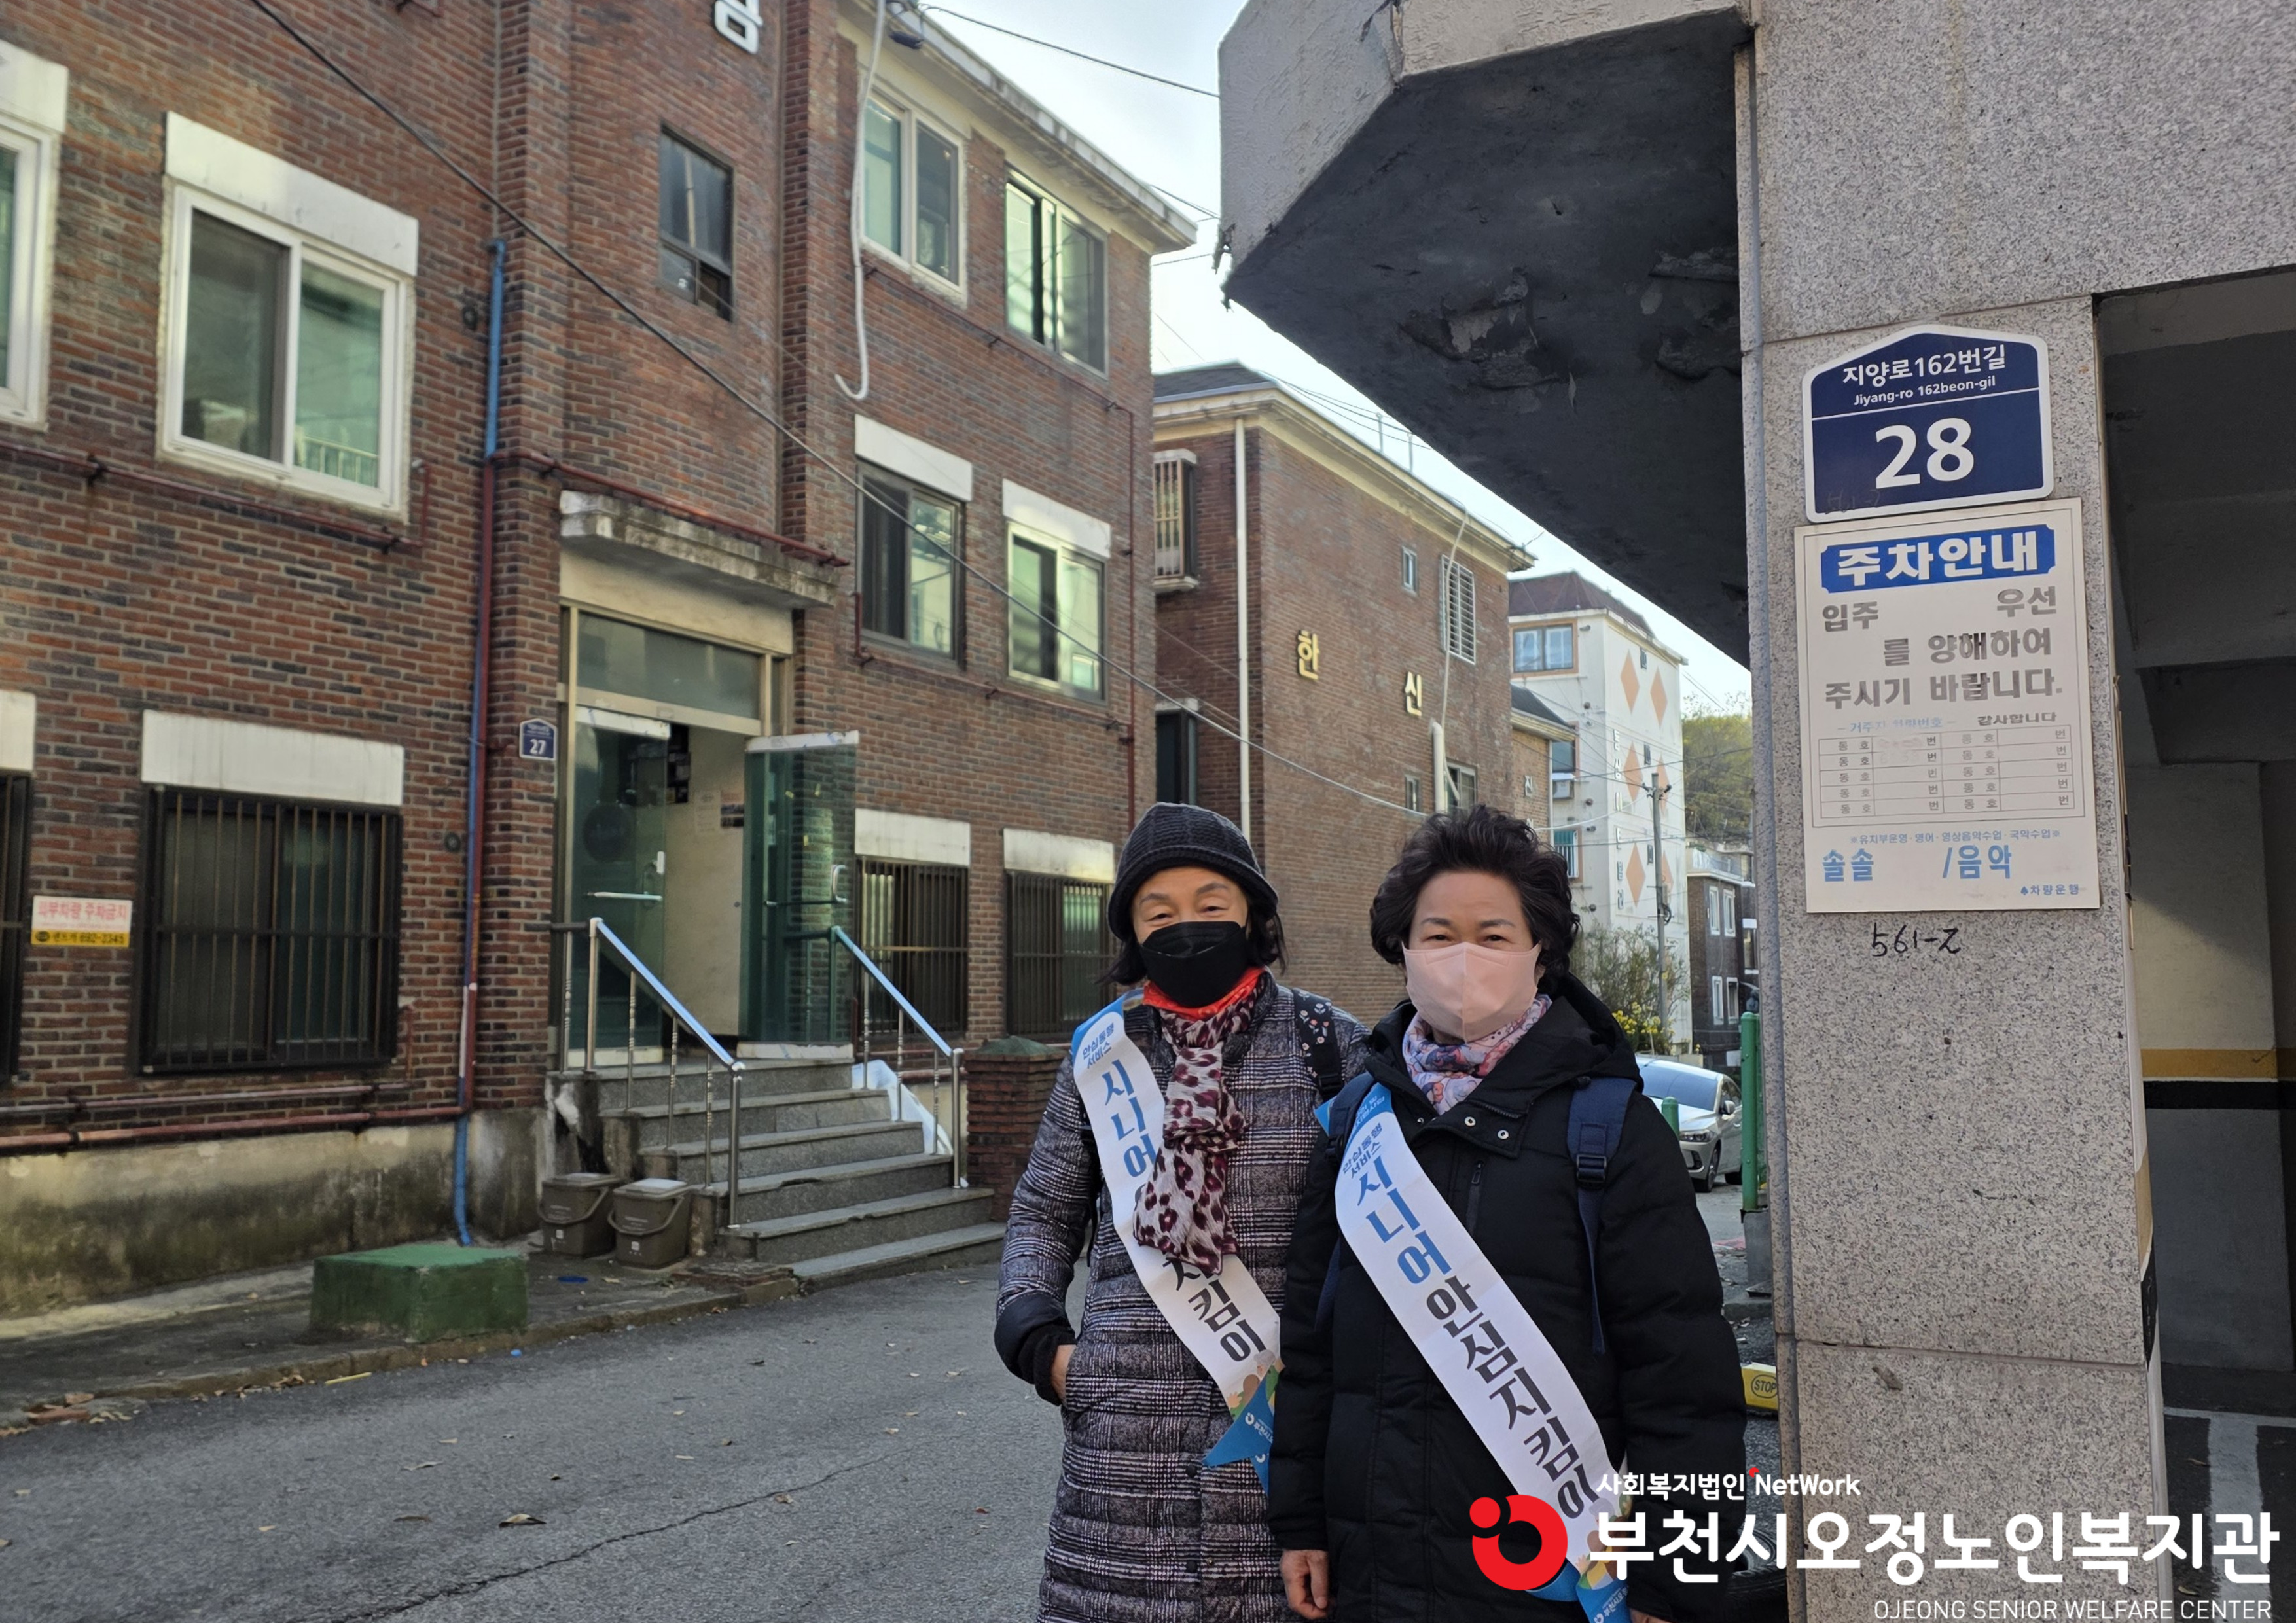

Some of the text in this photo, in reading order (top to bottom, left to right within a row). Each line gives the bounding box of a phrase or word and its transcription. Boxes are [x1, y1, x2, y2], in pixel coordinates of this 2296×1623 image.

[1842, 344, 2005, 388] 지양로162번길
[1854, 376, 1996, 407] Jiyang-ro 162beon-gil
[1875, 418, 1974, 489] 28
[1838, 531, 2037, 586] 주차안내
[1822, 586, 2056, 632] 입주 우선
[1884, 627, 2051, 666] 를 양해하여
[1297, 630, 1422, 717] 한 신
[1825, 668, 2062, 709] 주시기 바랍니다.
[1977, 712, 2056, 726] 감사합니다
[529, 739, 546, 755] 27
[1822, 848, 1874, 882] 솔솔
[1102, 1059, 1157, 1177] 시니어
[1754, 1379, 1776, 1393] STOP
